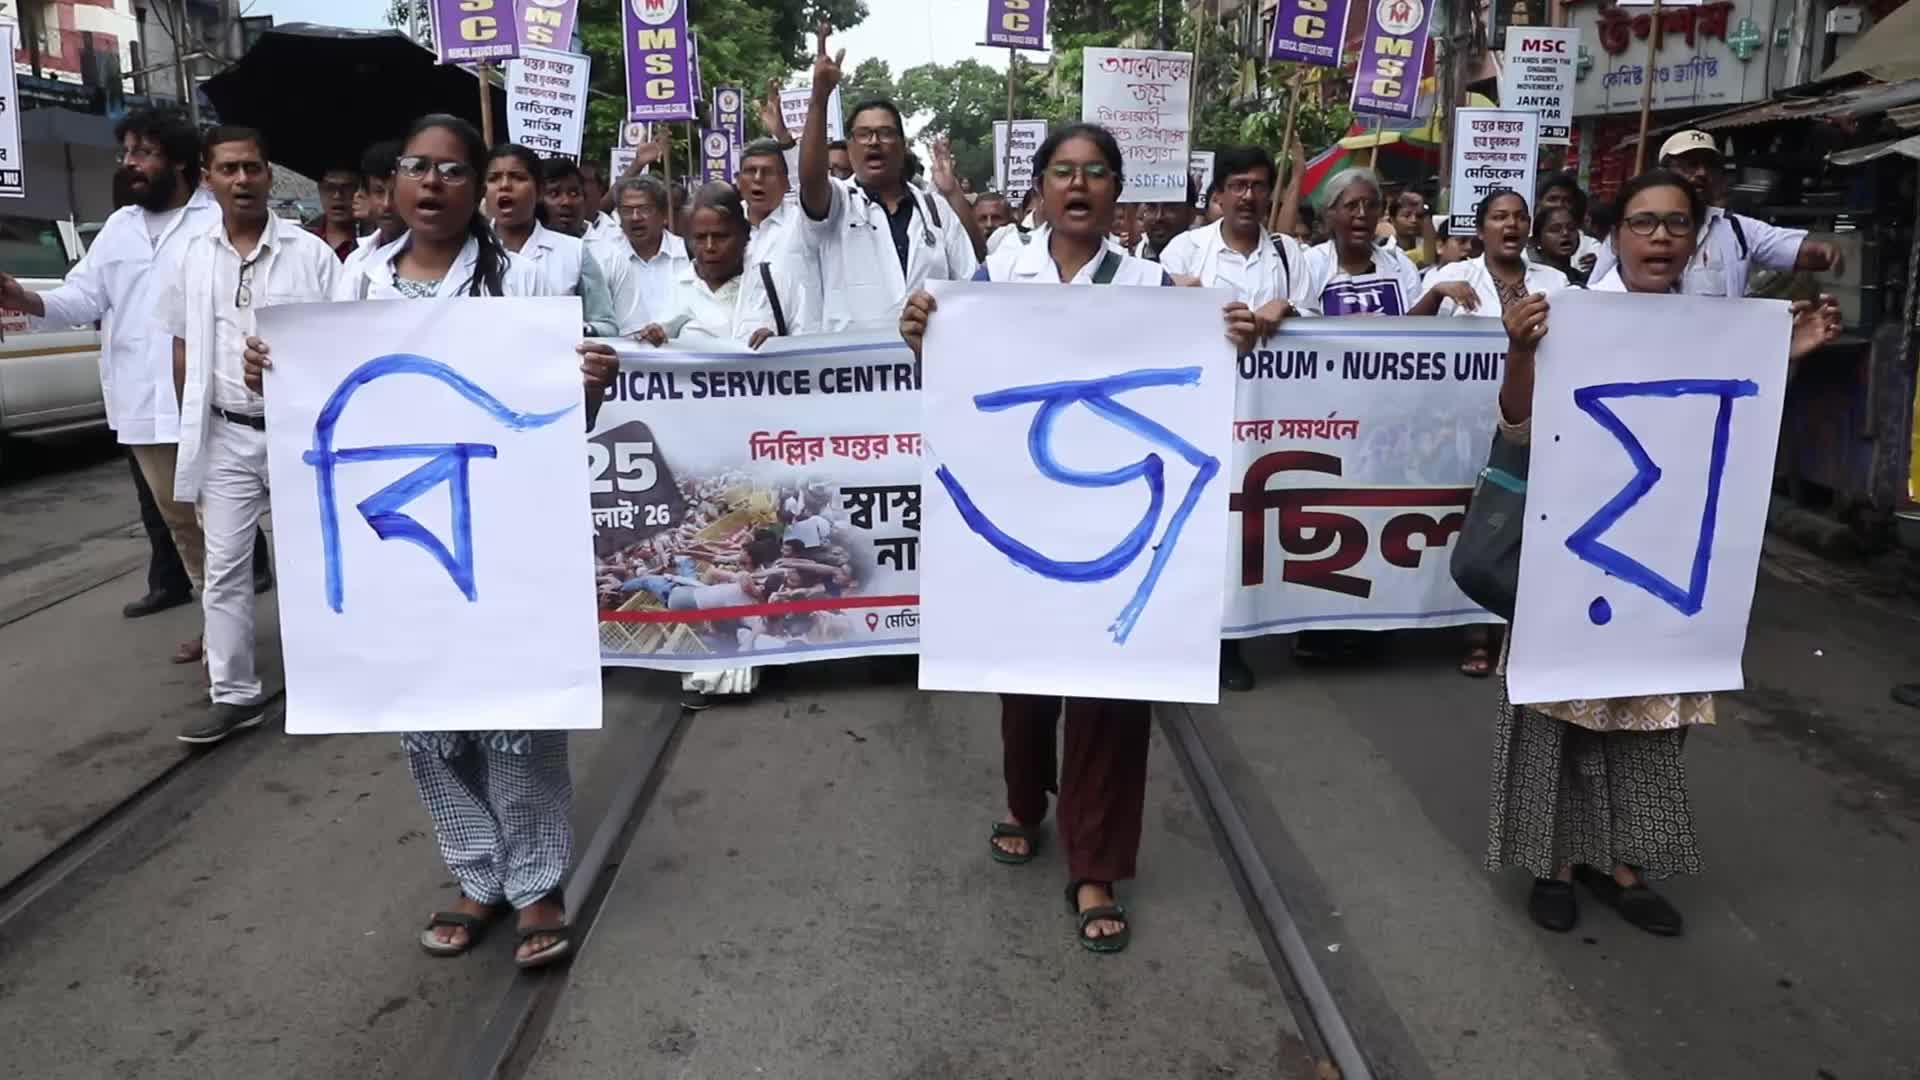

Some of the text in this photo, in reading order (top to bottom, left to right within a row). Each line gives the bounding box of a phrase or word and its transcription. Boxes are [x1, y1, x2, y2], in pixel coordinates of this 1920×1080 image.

[1521, 39, 1567, 53] MSC
[637, 27, 677, 100] MSC
[1371, 35, 1414, 98] MSC
[514, 100, 573, 119] মেডিকেল
[1516, 96, 1560, 107] JANTAR
[1540, 109, 1561, 119] TAR
[522, 117, 562, 133] সার্ভিস
[1472, 120, 1524, 133] যন্তর মন্তরে
[520, 134, 562, 149] সেন্টার
[4, 172, 19, 185] NU
[1465, 164, 1524, 179] মেডিকেল
[1455, 217, 1477, 227] MSC
[1343, 352, 1446, 381] NURSES
[692, 368, 811, 399] SERVICE
[1233, 411, 1360, 443] নের সমর্থনে
[750, 430, 824, 465] দিল্লির
[830, 434, 889, 460] যন্তর
[587, 441, 658, 493] 25
[303, 353, 577, 614] বি
[592, 498, 671, 536] লাই' 26
[936, 366, 1220, 644] জ
[1564, 379, 1760, 626] য়
